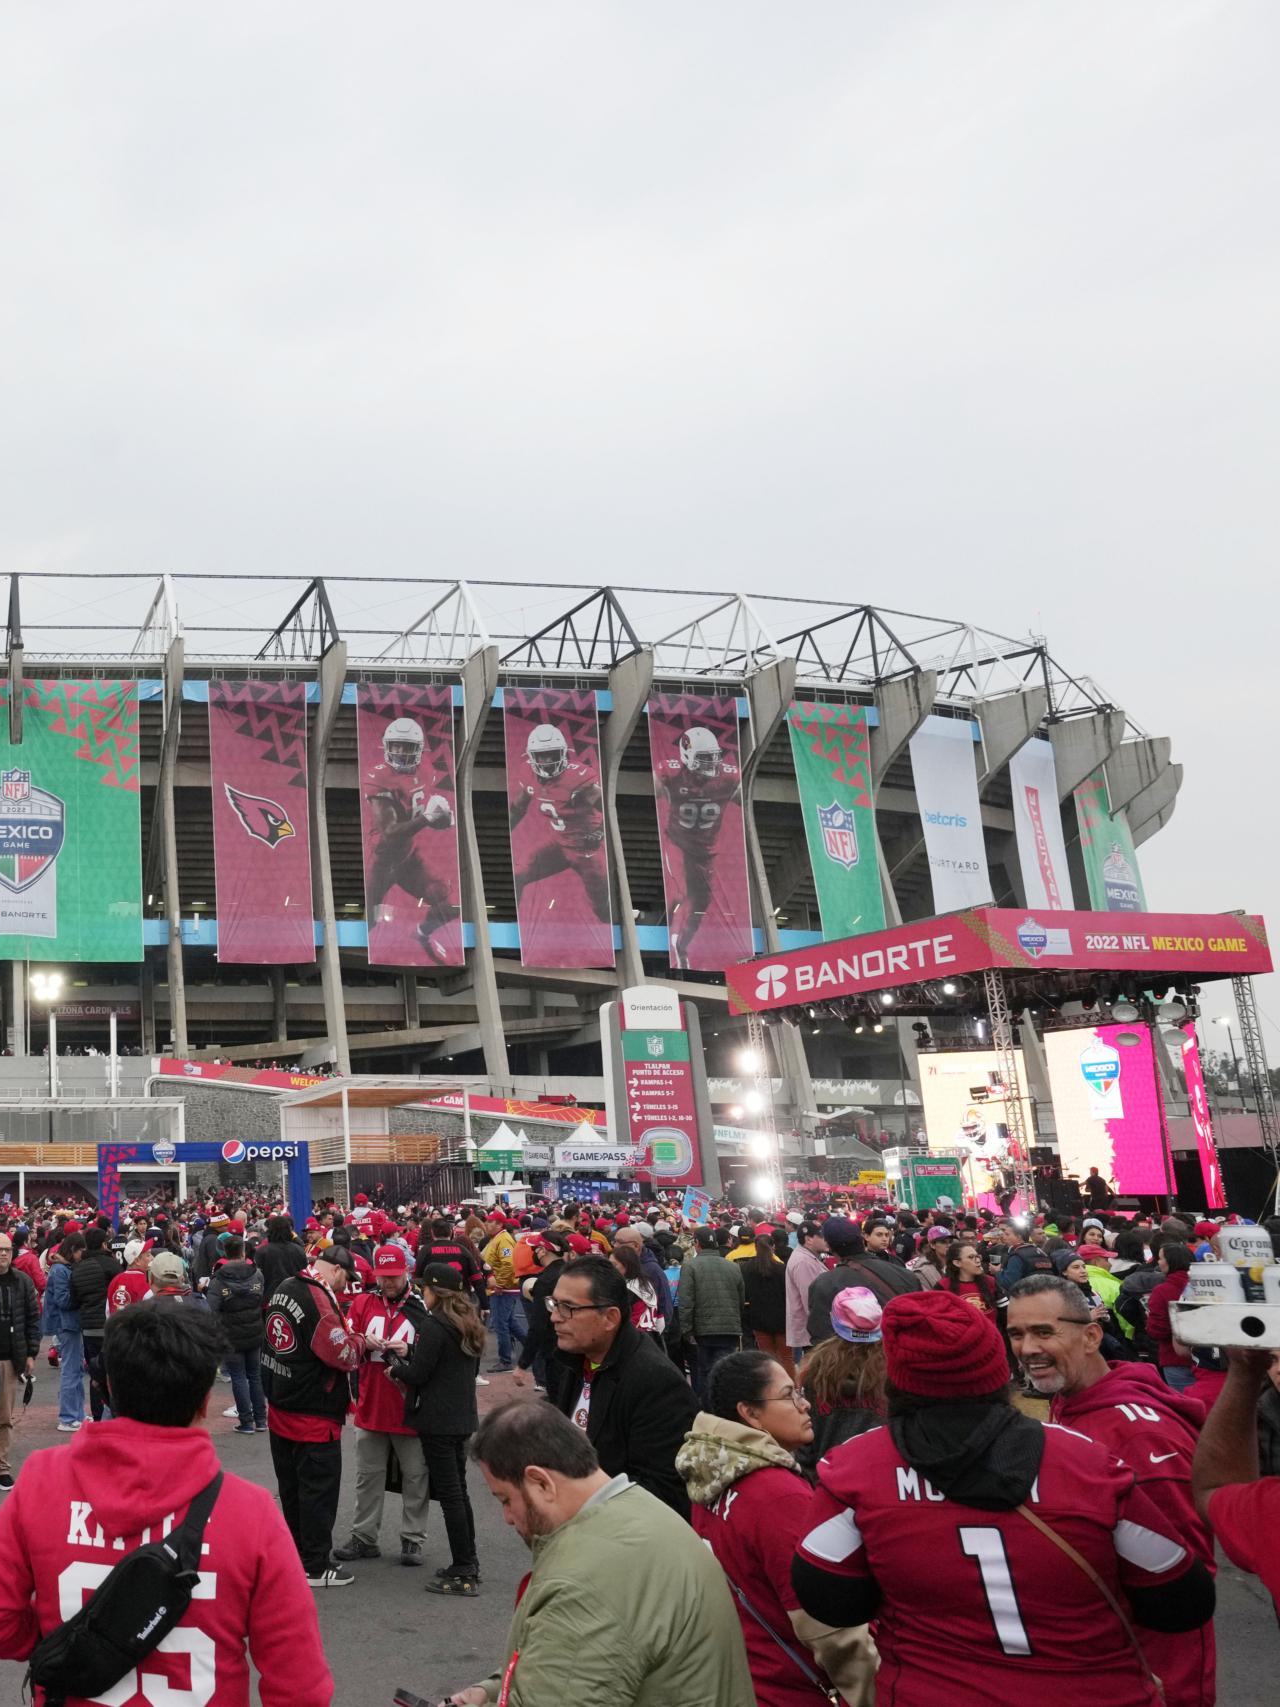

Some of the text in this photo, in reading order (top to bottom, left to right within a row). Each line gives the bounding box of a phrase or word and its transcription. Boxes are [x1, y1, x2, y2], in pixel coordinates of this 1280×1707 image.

[5, 783, 28, 799] NFL
[540, 802, 566, 832] 3
[678, 802, 721, 829] 99
[3, 841, 31, 849] GAME
[825, 829, 858, 859] NFL
[1, 910, 48, 919] BANORTE
[1085, 935, 1119, 950] 2022
[1123, 935, 1150, 951] NFL
[1152, 936, 1204, 952] MEXICO
[1210, 937, 1248, 952] GAME
[794, 934, 956, 991] BANORTE
[47, 1006, 131, 1016] AIZONA CARDIALS
[290, 1076, 320, 1088] WELCO
[443, 1095, 464, 1105] GAM
[245, 1142, 299, 1162] pepsi
[431, 1246, 462, 1255] MONTANA
[365, 1315, 416, 1362] 44
[957, 1524, 1032, 1657] 1
[136, 1612, 163, 1640] Timberland
